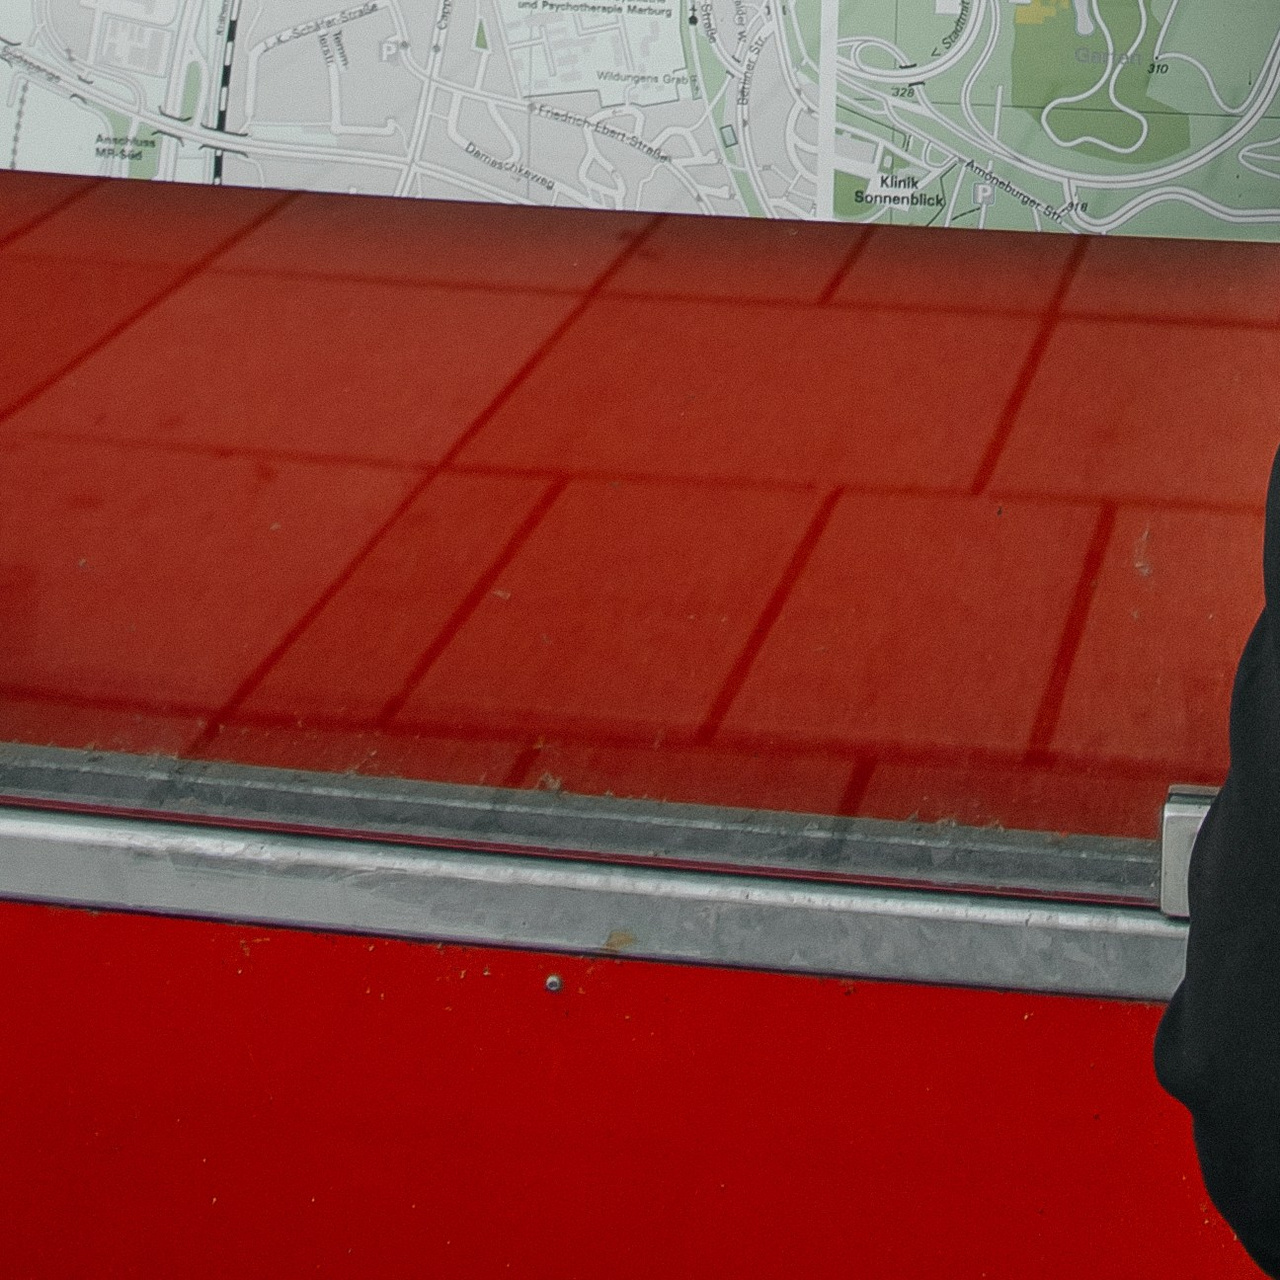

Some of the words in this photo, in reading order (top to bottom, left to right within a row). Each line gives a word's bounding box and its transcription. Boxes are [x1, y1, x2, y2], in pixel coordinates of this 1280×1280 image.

[1148, 64, 1168, 74] 310
[891, 87, 915, 98] 328
[880, 175, 919, 190] Klinik
[854, 190, 945, 208] Sonnenblick
